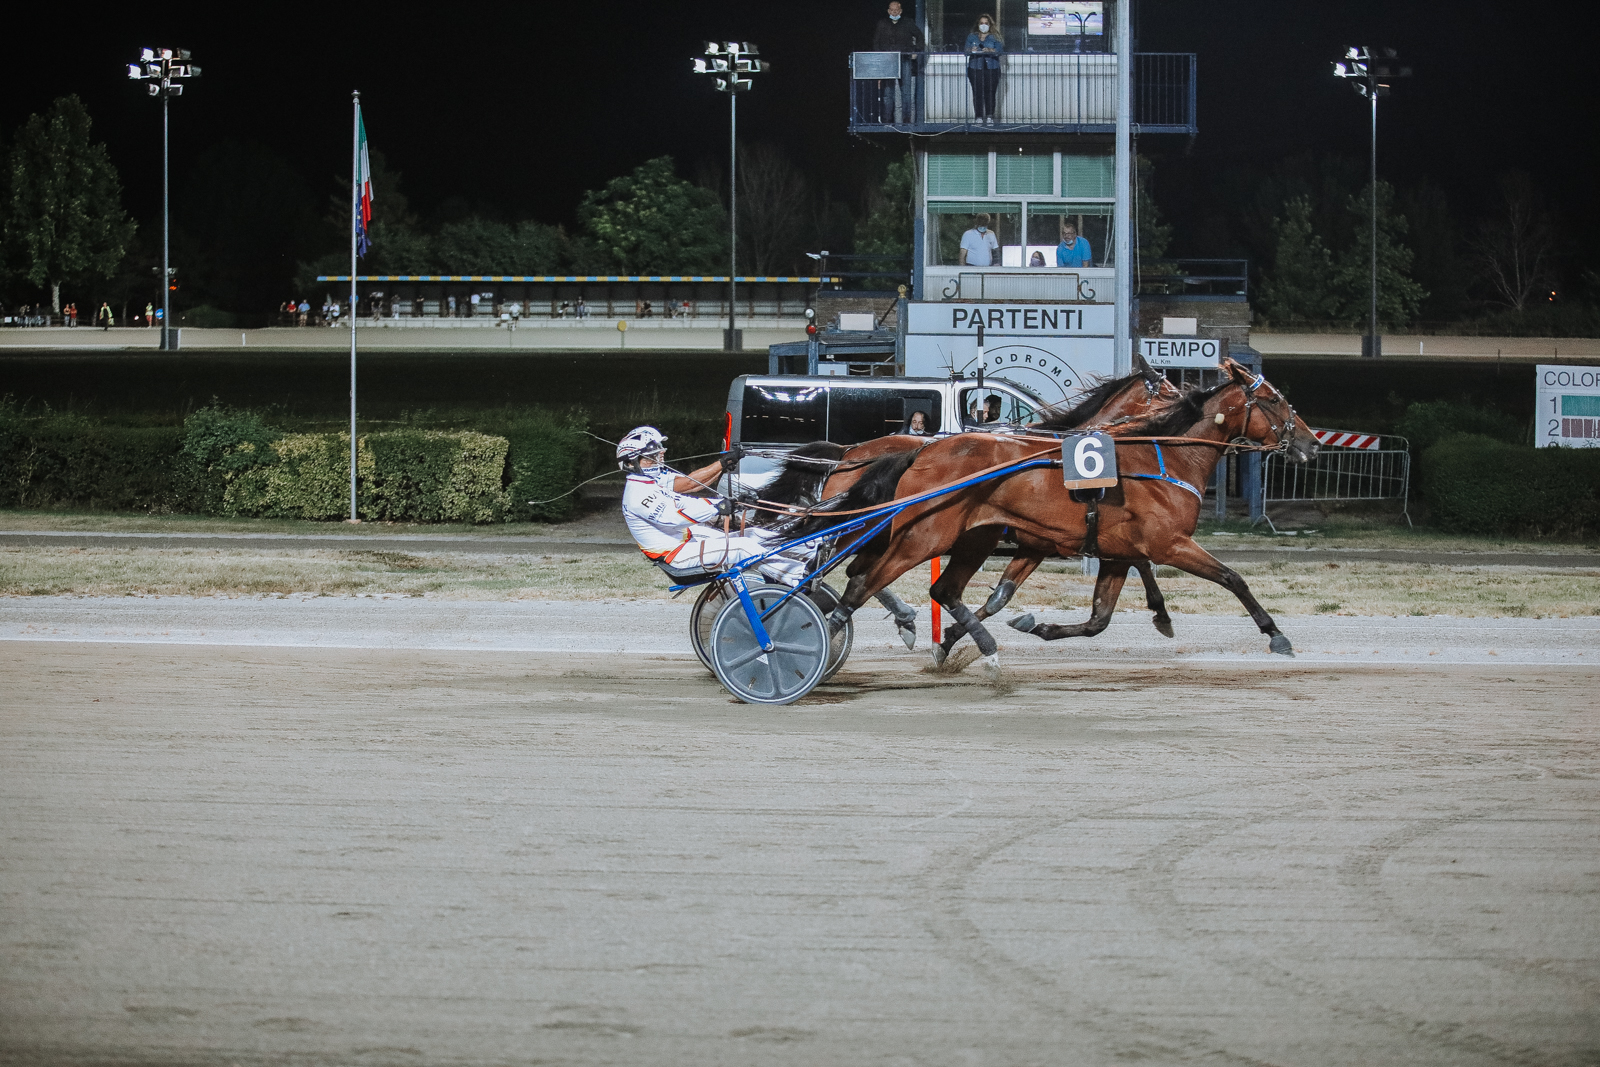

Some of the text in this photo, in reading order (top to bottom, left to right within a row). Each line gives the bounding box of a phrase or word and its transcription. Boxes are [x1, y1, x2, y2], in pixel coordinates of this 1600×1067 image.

[952, 308, 1082, 329] PARTENTI
[1144, 341, 1216, 357] TEMPO
[1549, 396, 1557, 414] 1
[1548, 418, 1560, 437] 2
[1074, 436, 1105, 479] 6
